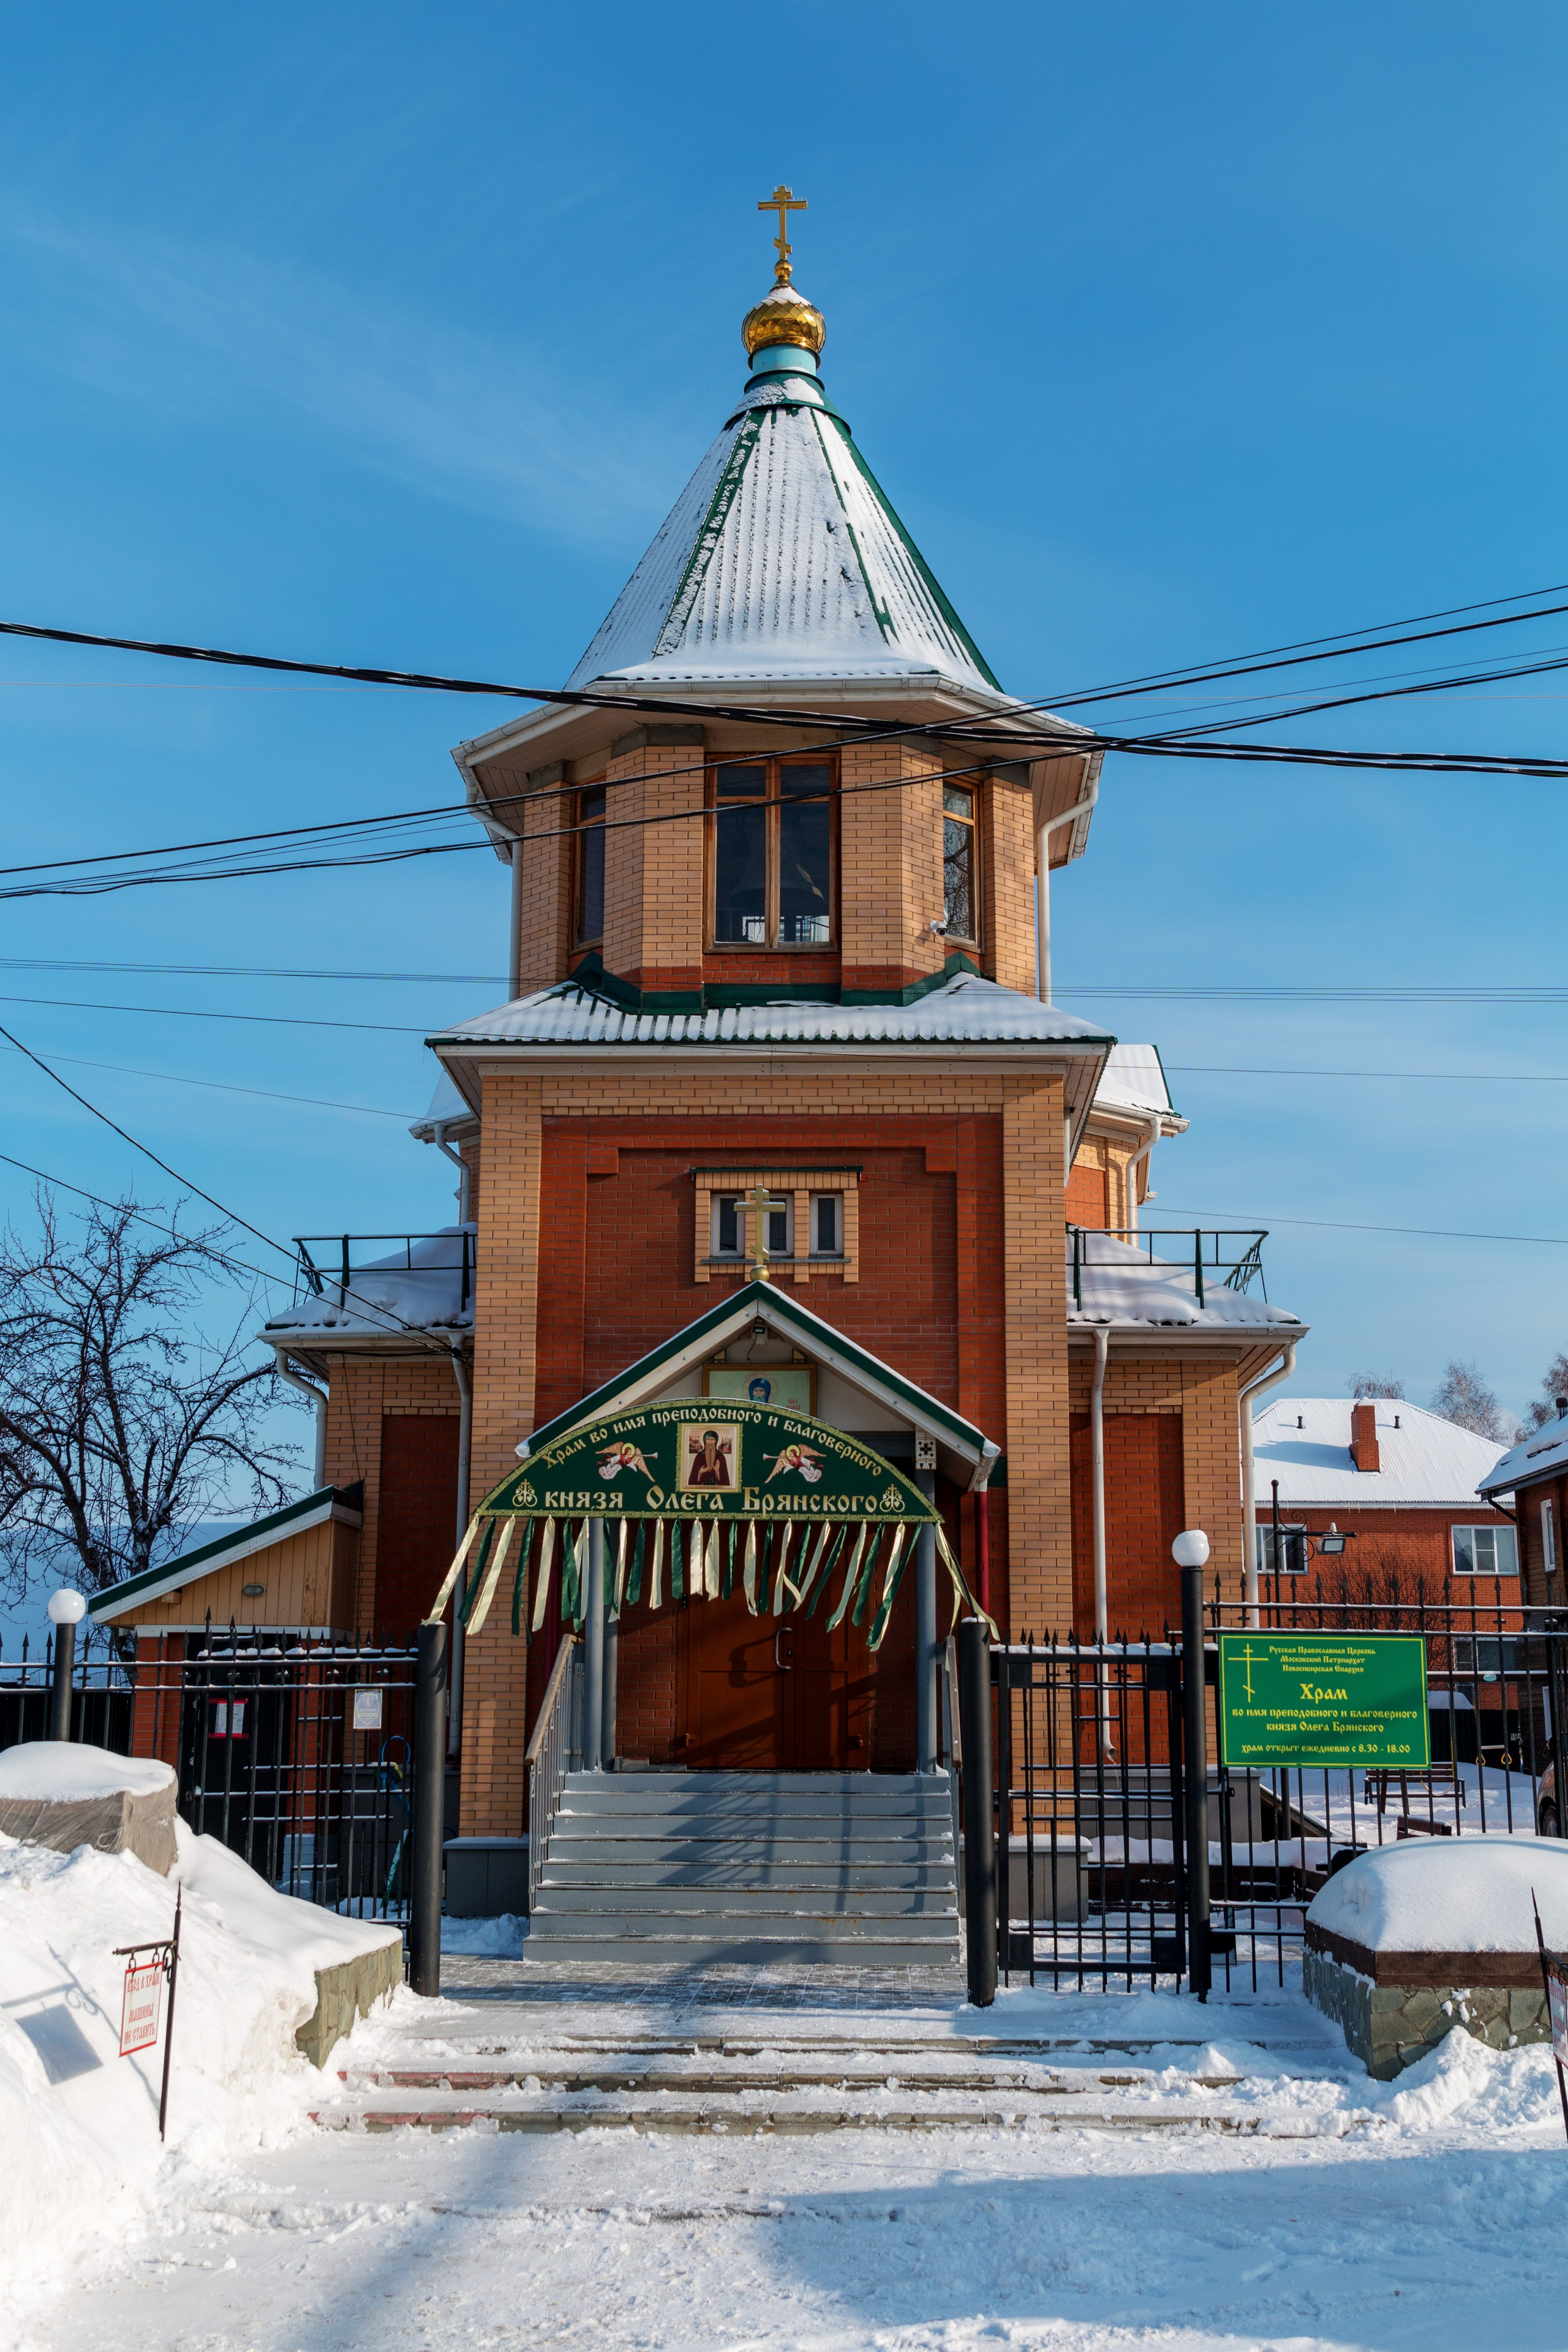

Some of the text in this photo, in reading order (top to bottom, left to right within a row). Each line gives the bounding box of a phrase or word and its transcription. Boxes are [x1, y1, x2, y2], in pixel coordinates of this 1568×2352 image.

[541, 1408, 882, 1476] Храм во имя преподобного и благоверного
[545, 1485, 878, 1518] князя Олега Брянского
[1269, 1646, 1296, 1654] Русская
[1347, 1647, 1376, 1656] Церковь
[1282, 1664, 1333, 1673] Новосибирская
[1323, 1656, 1365, 1665] Патриархат
[1300, 1683, 1348, 1704] Храм
[1270, 1709, 1338, 1719] преподобного
[1350, 1710, 1417, 1721] благоверного
[1299, 1721, 1329, 1732] Олега
[1332, 1722, 1384, 1734] Брянского
[1242, 1745, 1264, 1754] храм
[1265, 1745, 1299, 1754] открыт
[1359, 1744, 1378, 1753] 8.30
[1386, 1744, 1410, 1753] 18.00
[127, 1972, 160, 1992] ВХОД В ХРАМ
[129, 2003, 154, 2023] МАШИНЫ
[124, 2022, 155, 2045] НЕ СТАВИТЬ
